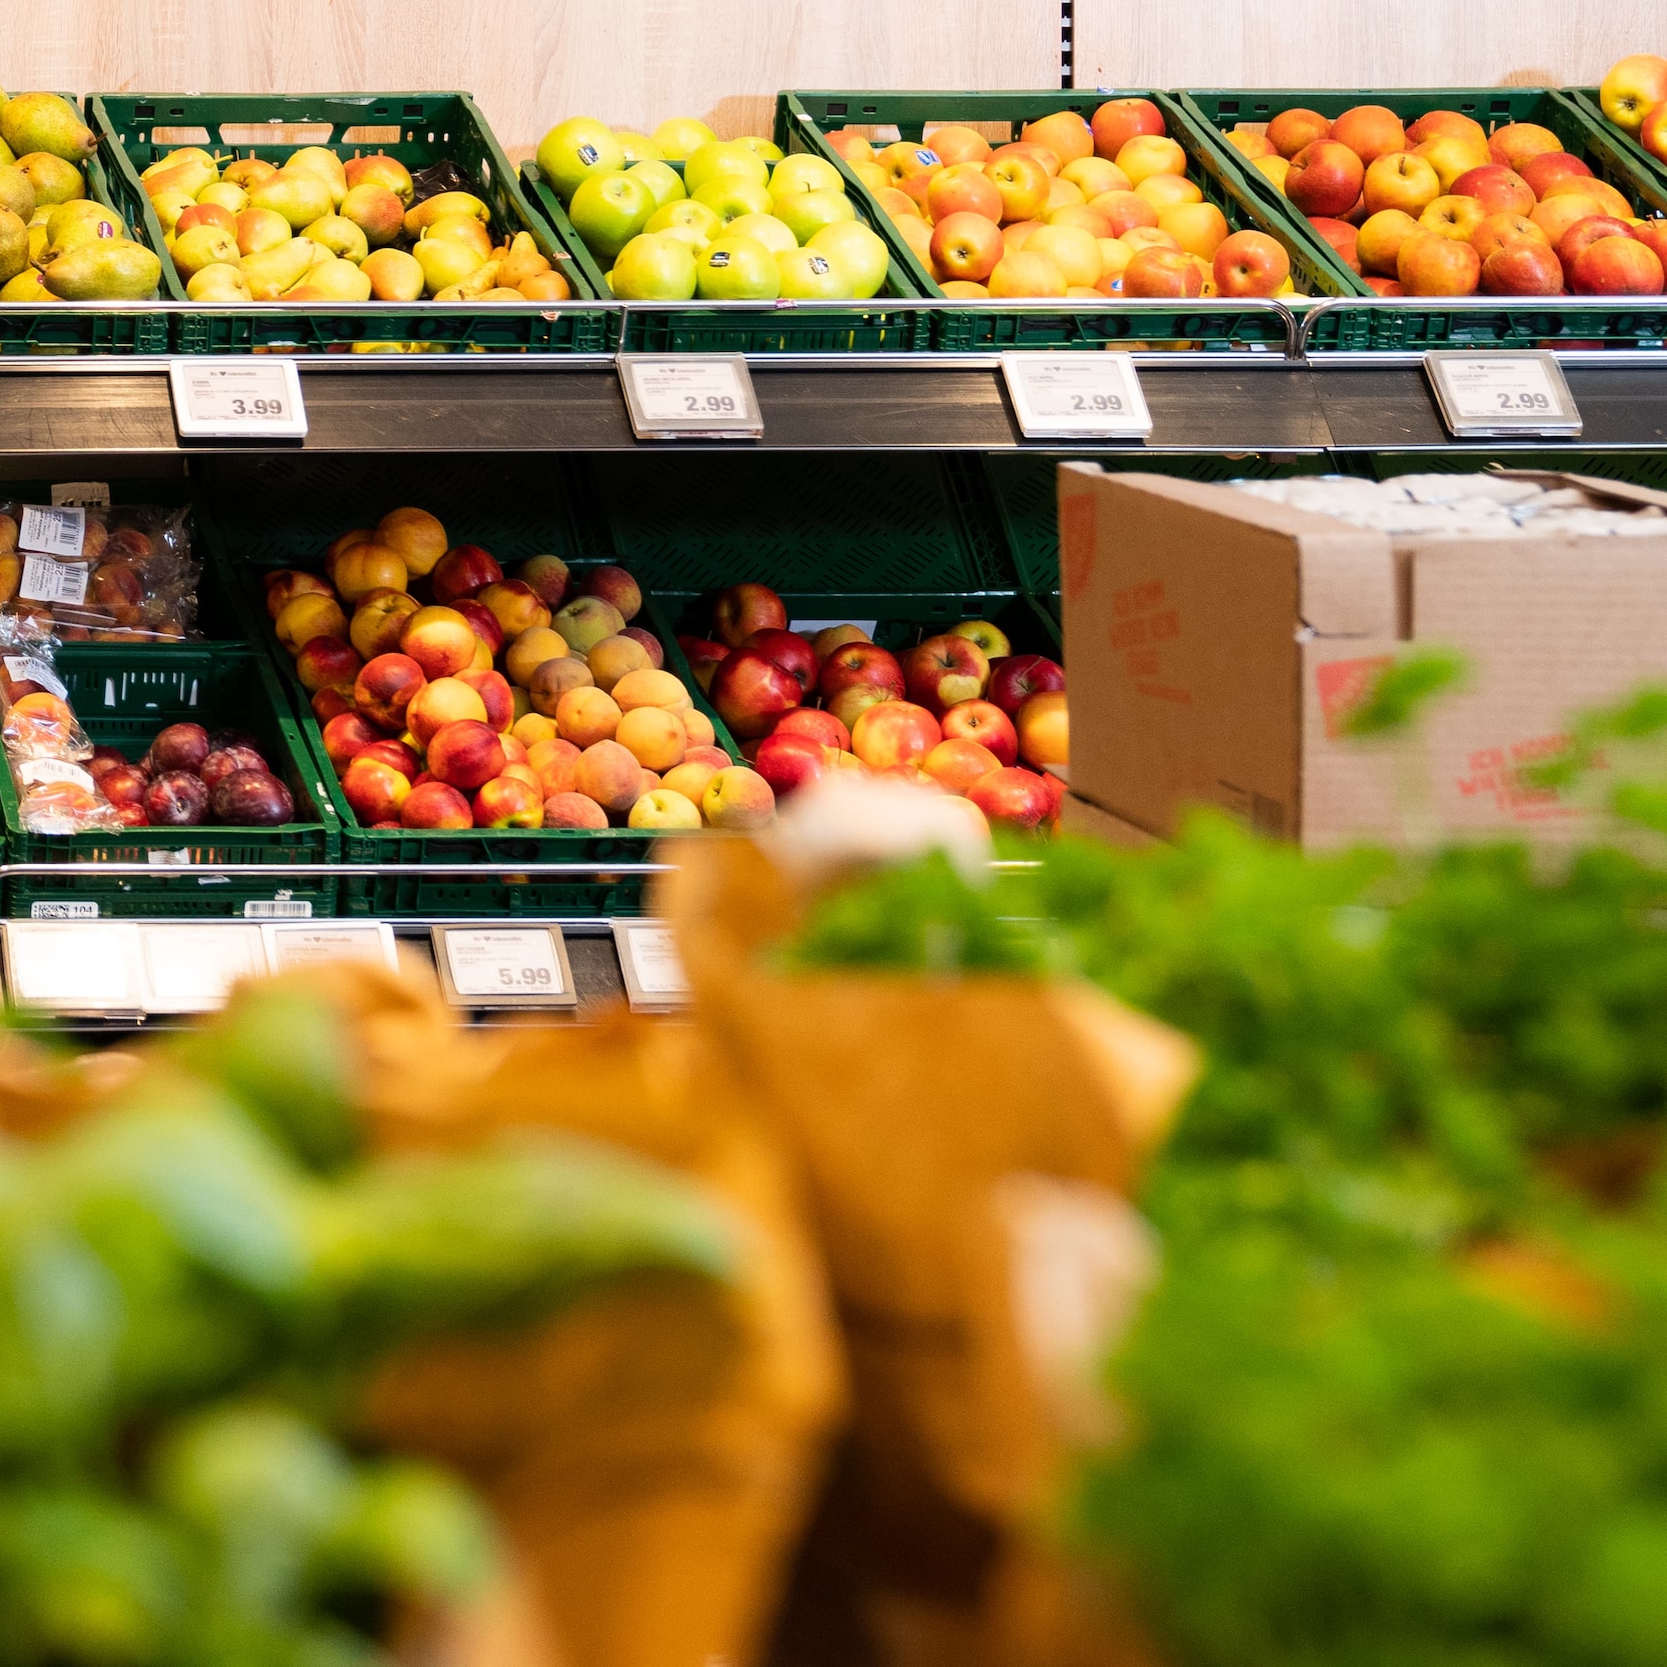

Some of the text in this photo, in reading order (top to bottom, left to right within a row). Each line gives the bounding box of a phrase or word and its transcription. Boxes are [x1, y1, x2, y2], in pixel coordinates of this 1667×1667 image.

[232, 399, 282, 415] 3.99
[684, 396, 735, 412] 2.99
[1070, 394, 1123, 411] 2.99
[1496, 393, 1550, 409] 2.99
[498, 967, 551, 985] 5.99
